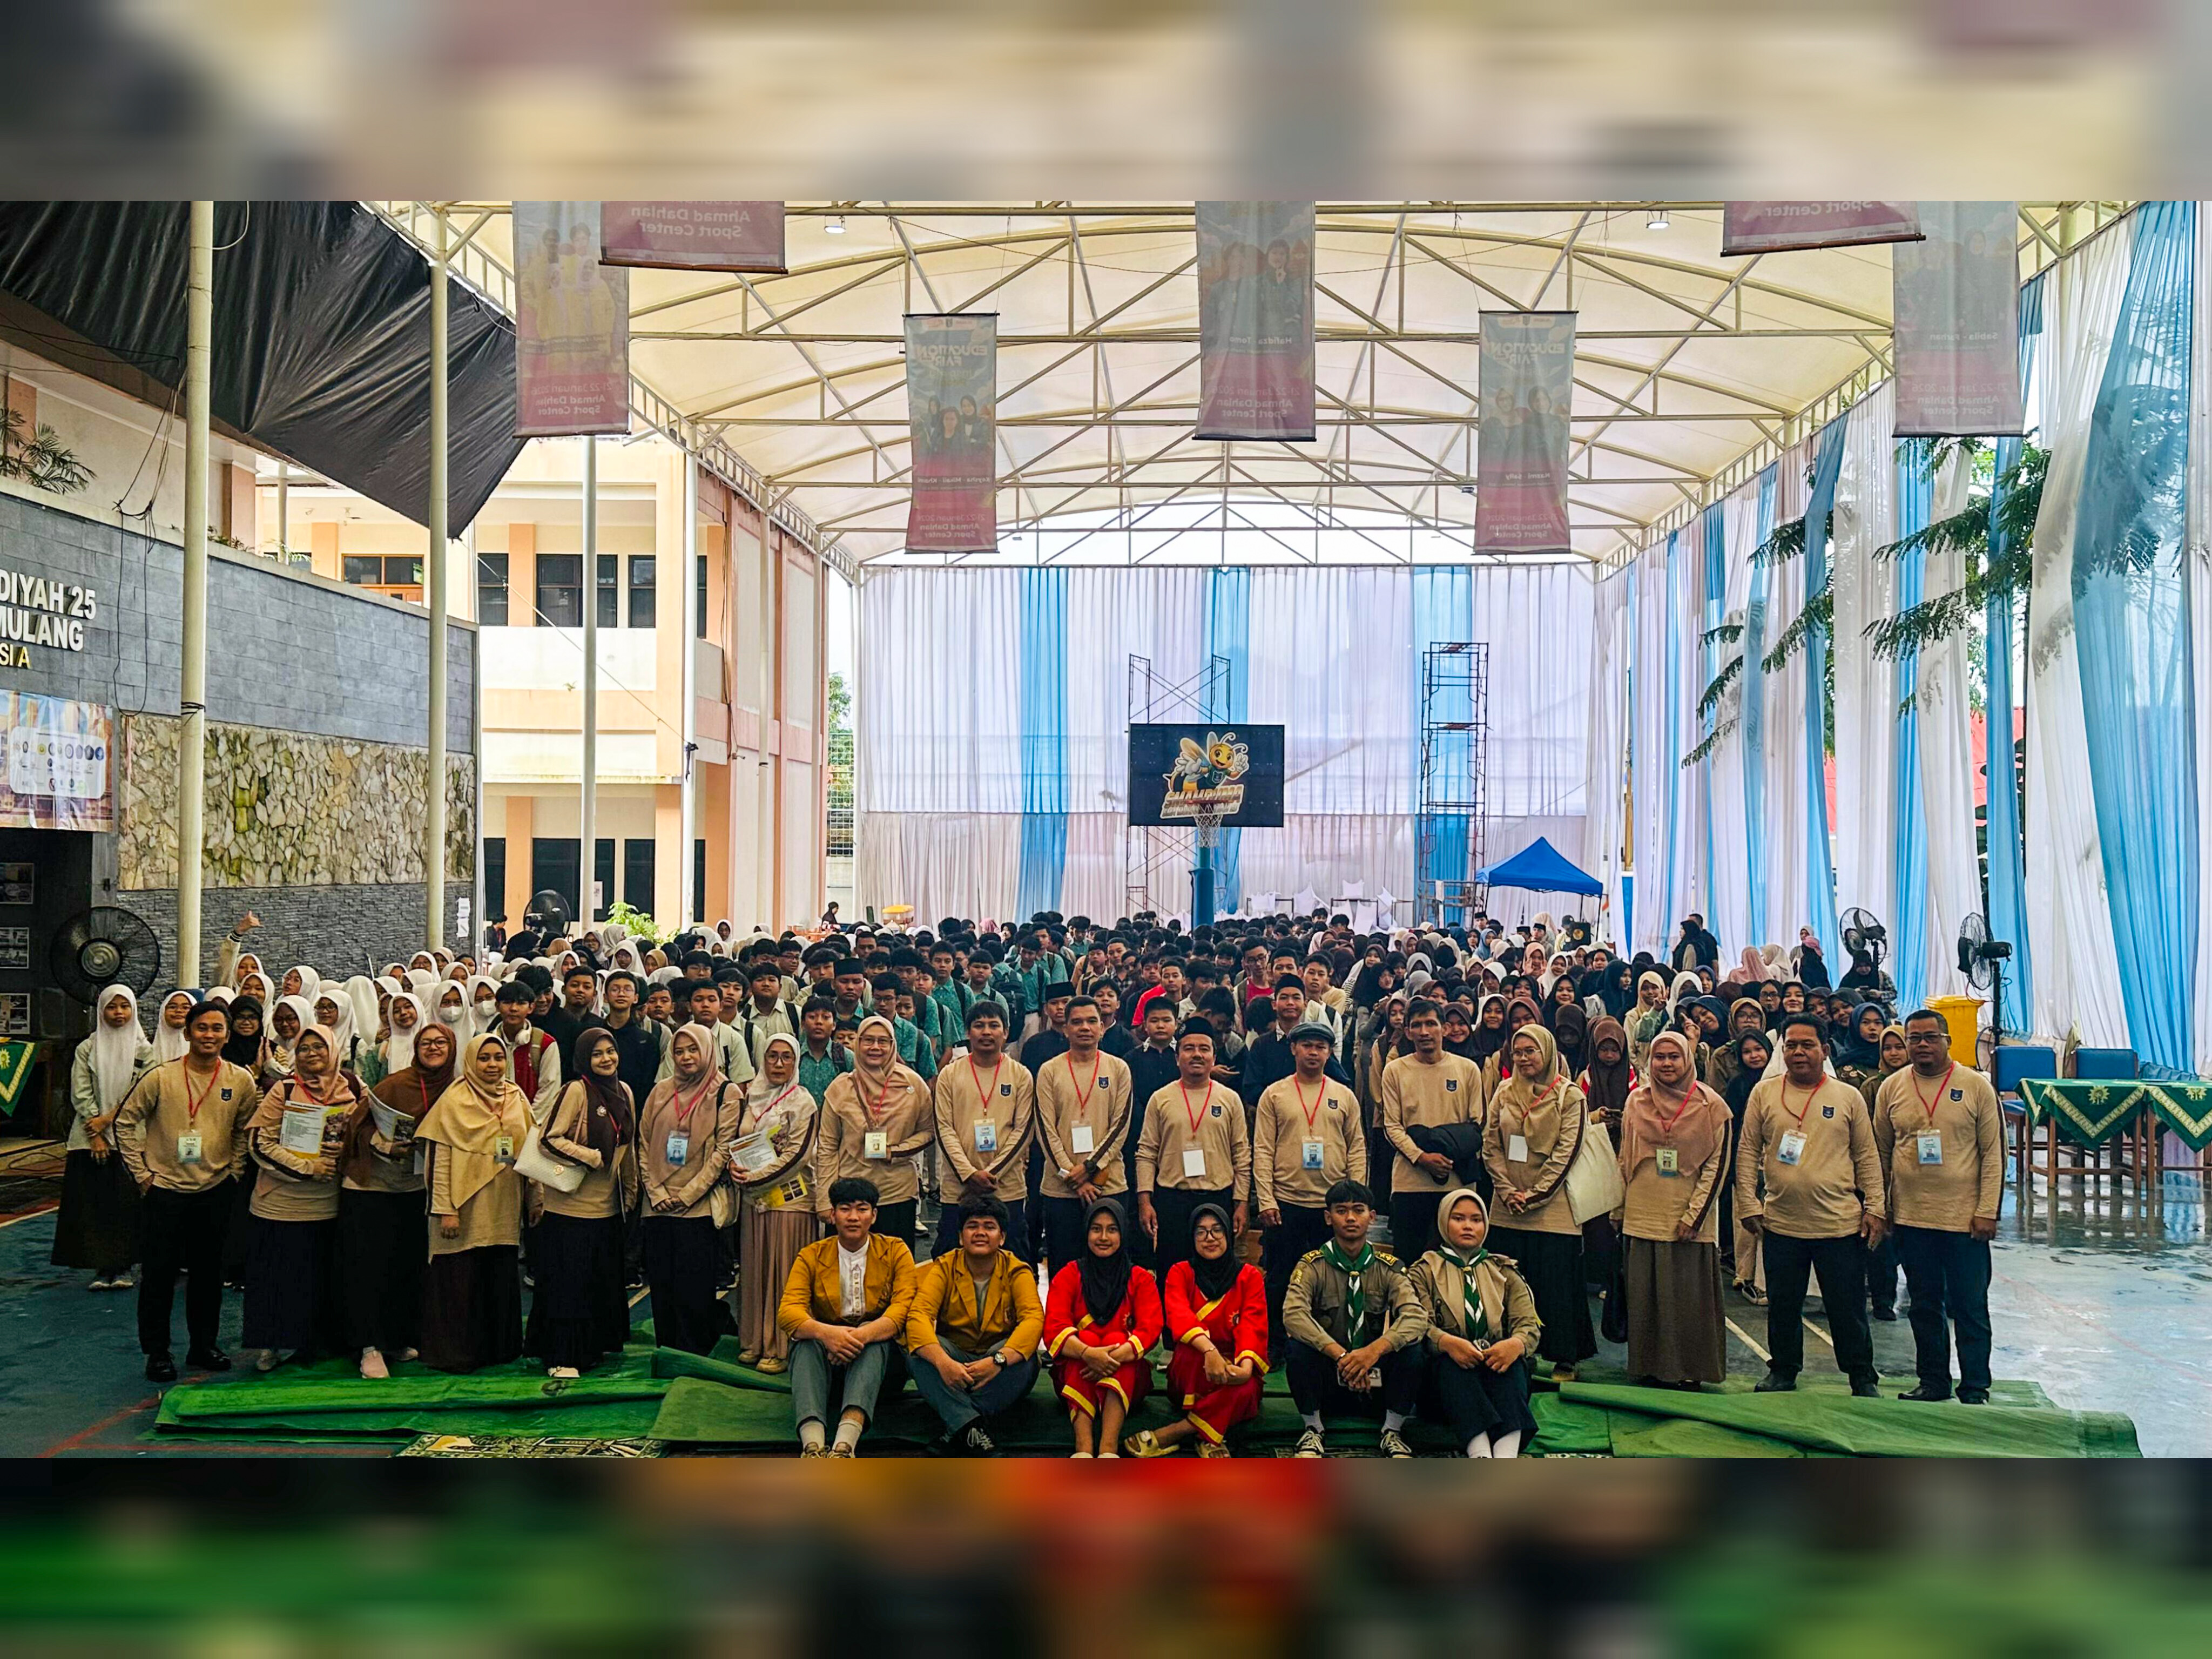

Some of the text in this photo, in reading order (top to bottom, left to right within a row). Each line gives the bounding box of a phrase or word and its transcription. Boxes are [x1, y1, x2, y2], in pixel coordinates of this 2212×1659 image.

[0, 569, 96, 619] DIYAH 25
[18, 646, 31, 669] A
